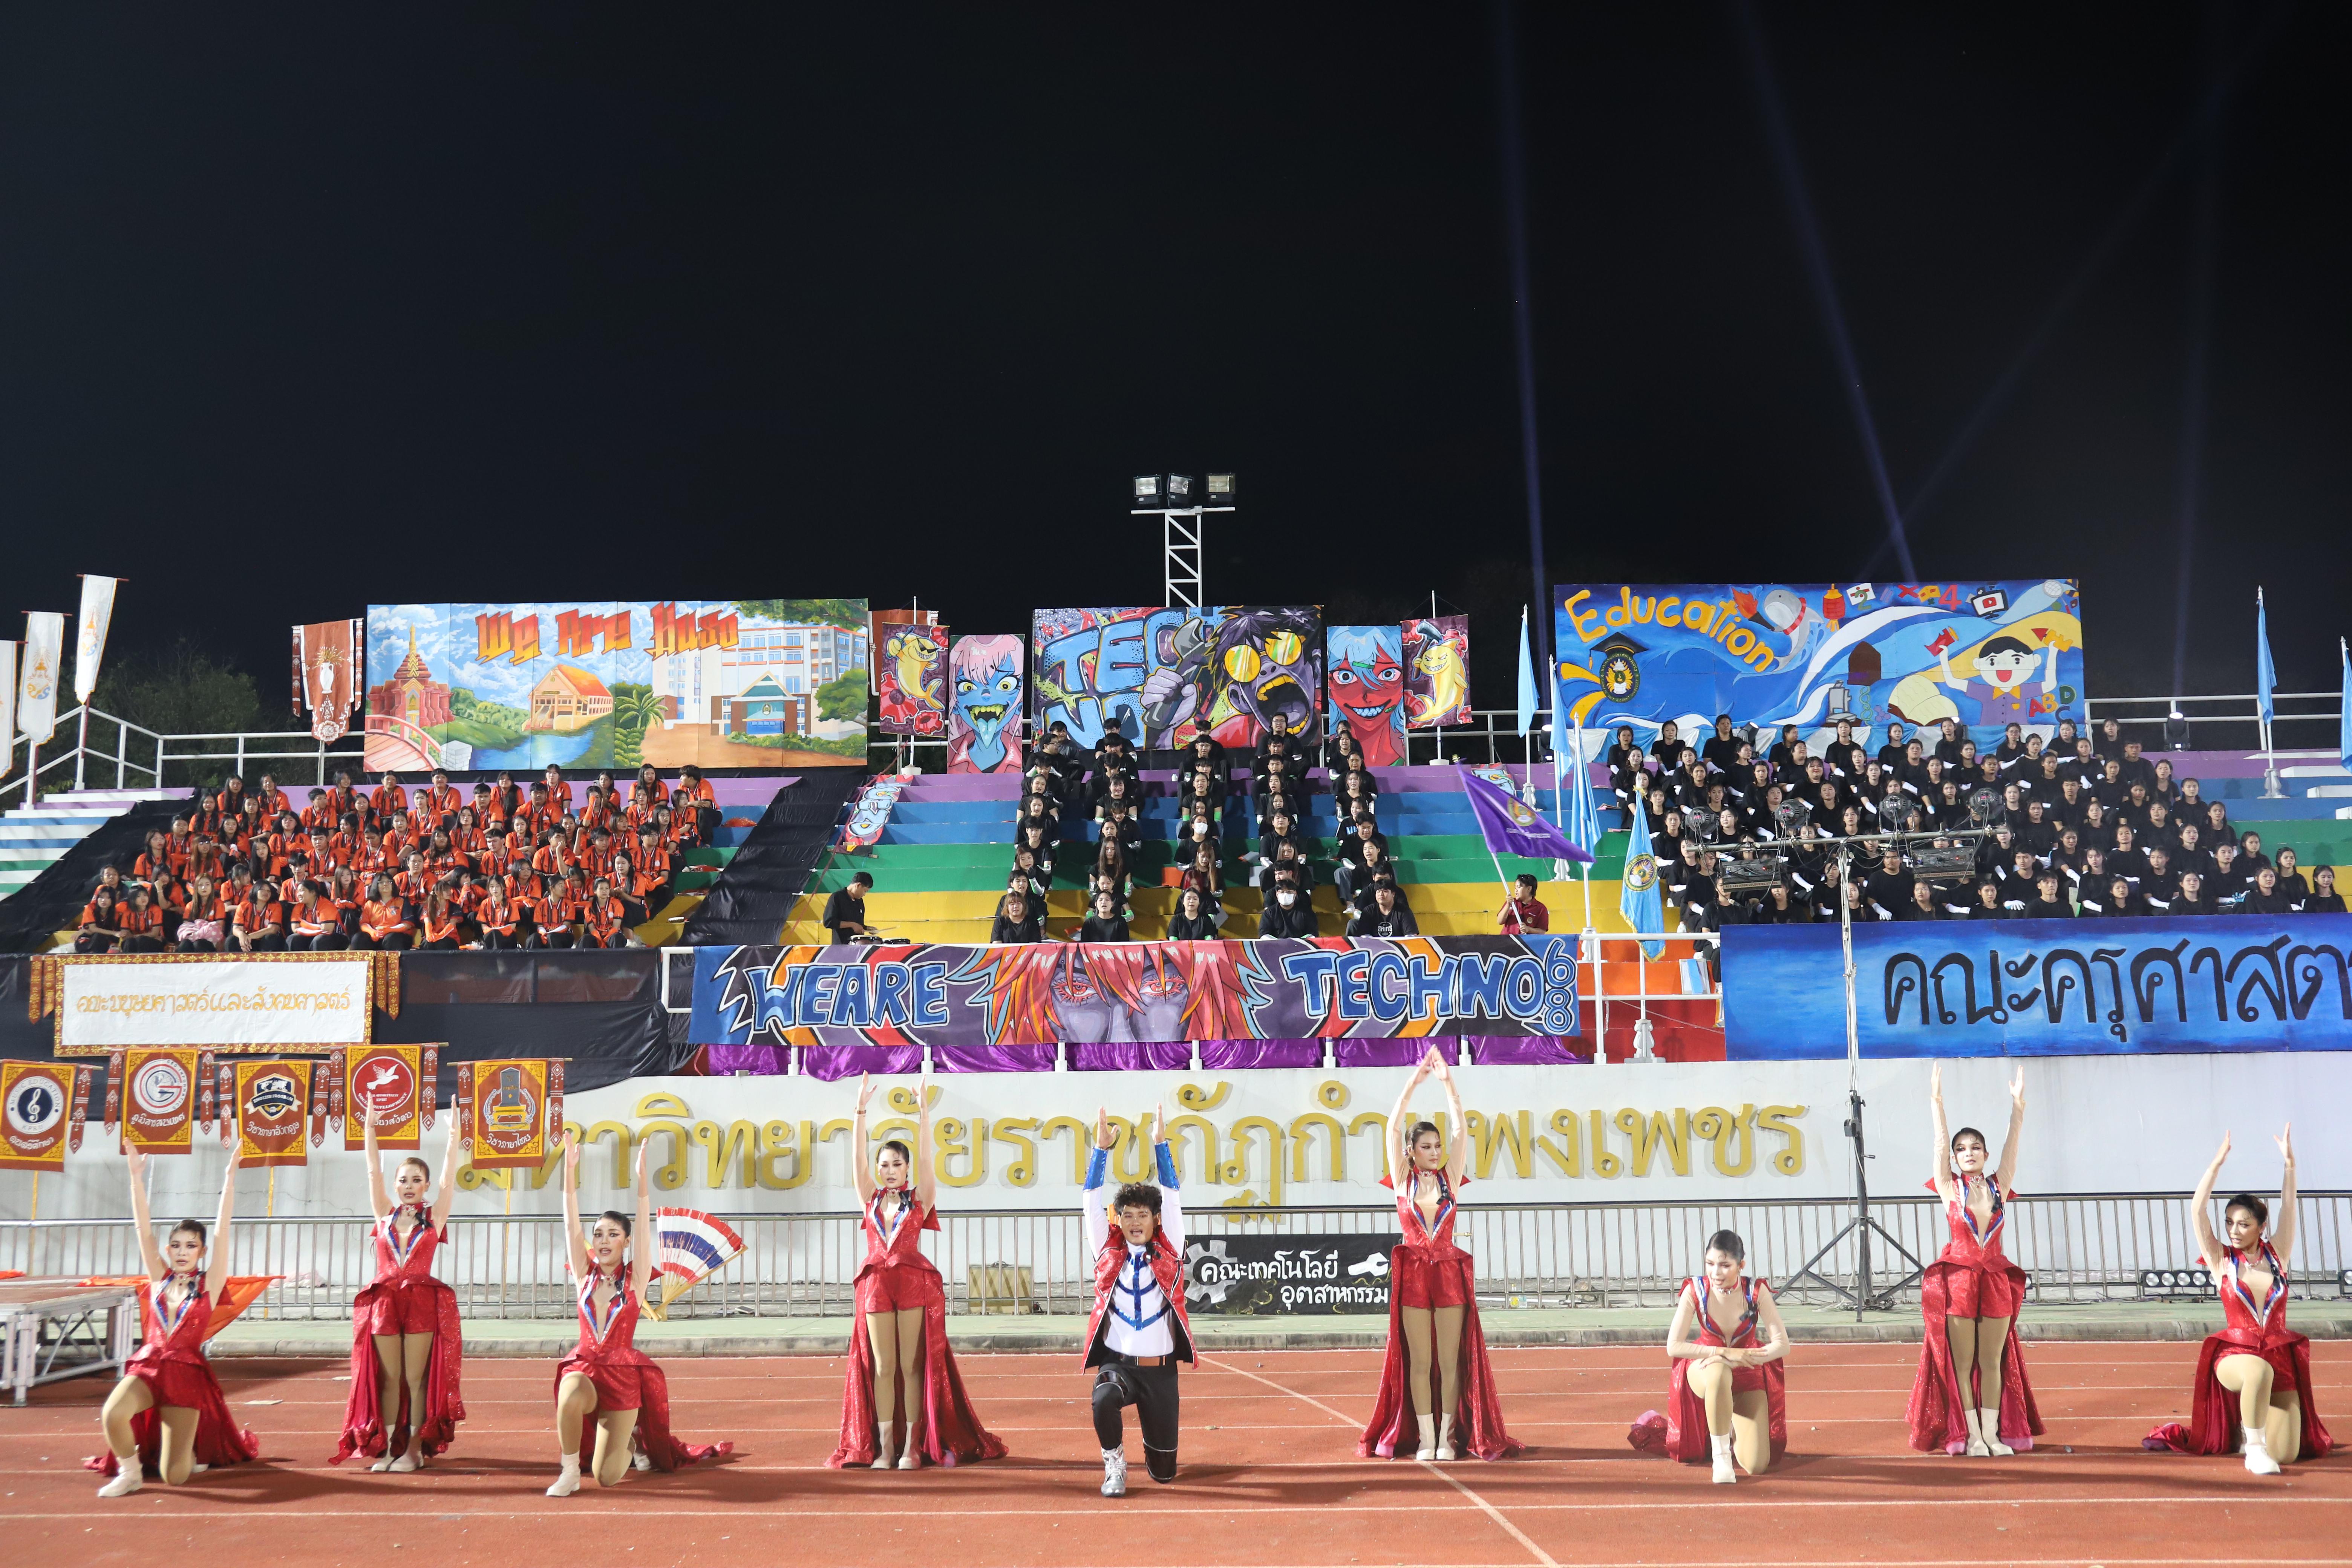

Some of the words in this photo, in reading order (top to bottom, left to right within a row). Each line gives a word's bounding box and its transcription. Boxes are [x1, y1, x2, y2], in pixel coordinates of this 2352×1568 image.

[475, 610, 542, 666] We
[1565, 586, 1774, 672] Education
[1280, 948, 1545, 1020] TECHNO
[1885, 934, 2352, 1043] คณะครุศาสต
[10, 1082, 26, 1104] MUSIC
[28, 1079, 61, 1108] EDUCATION
[1201, 1249, 1338, 1282] คณะเทคโนโลยี
[1280, 1283, 1388, 1310] อุตสาหกรรม
